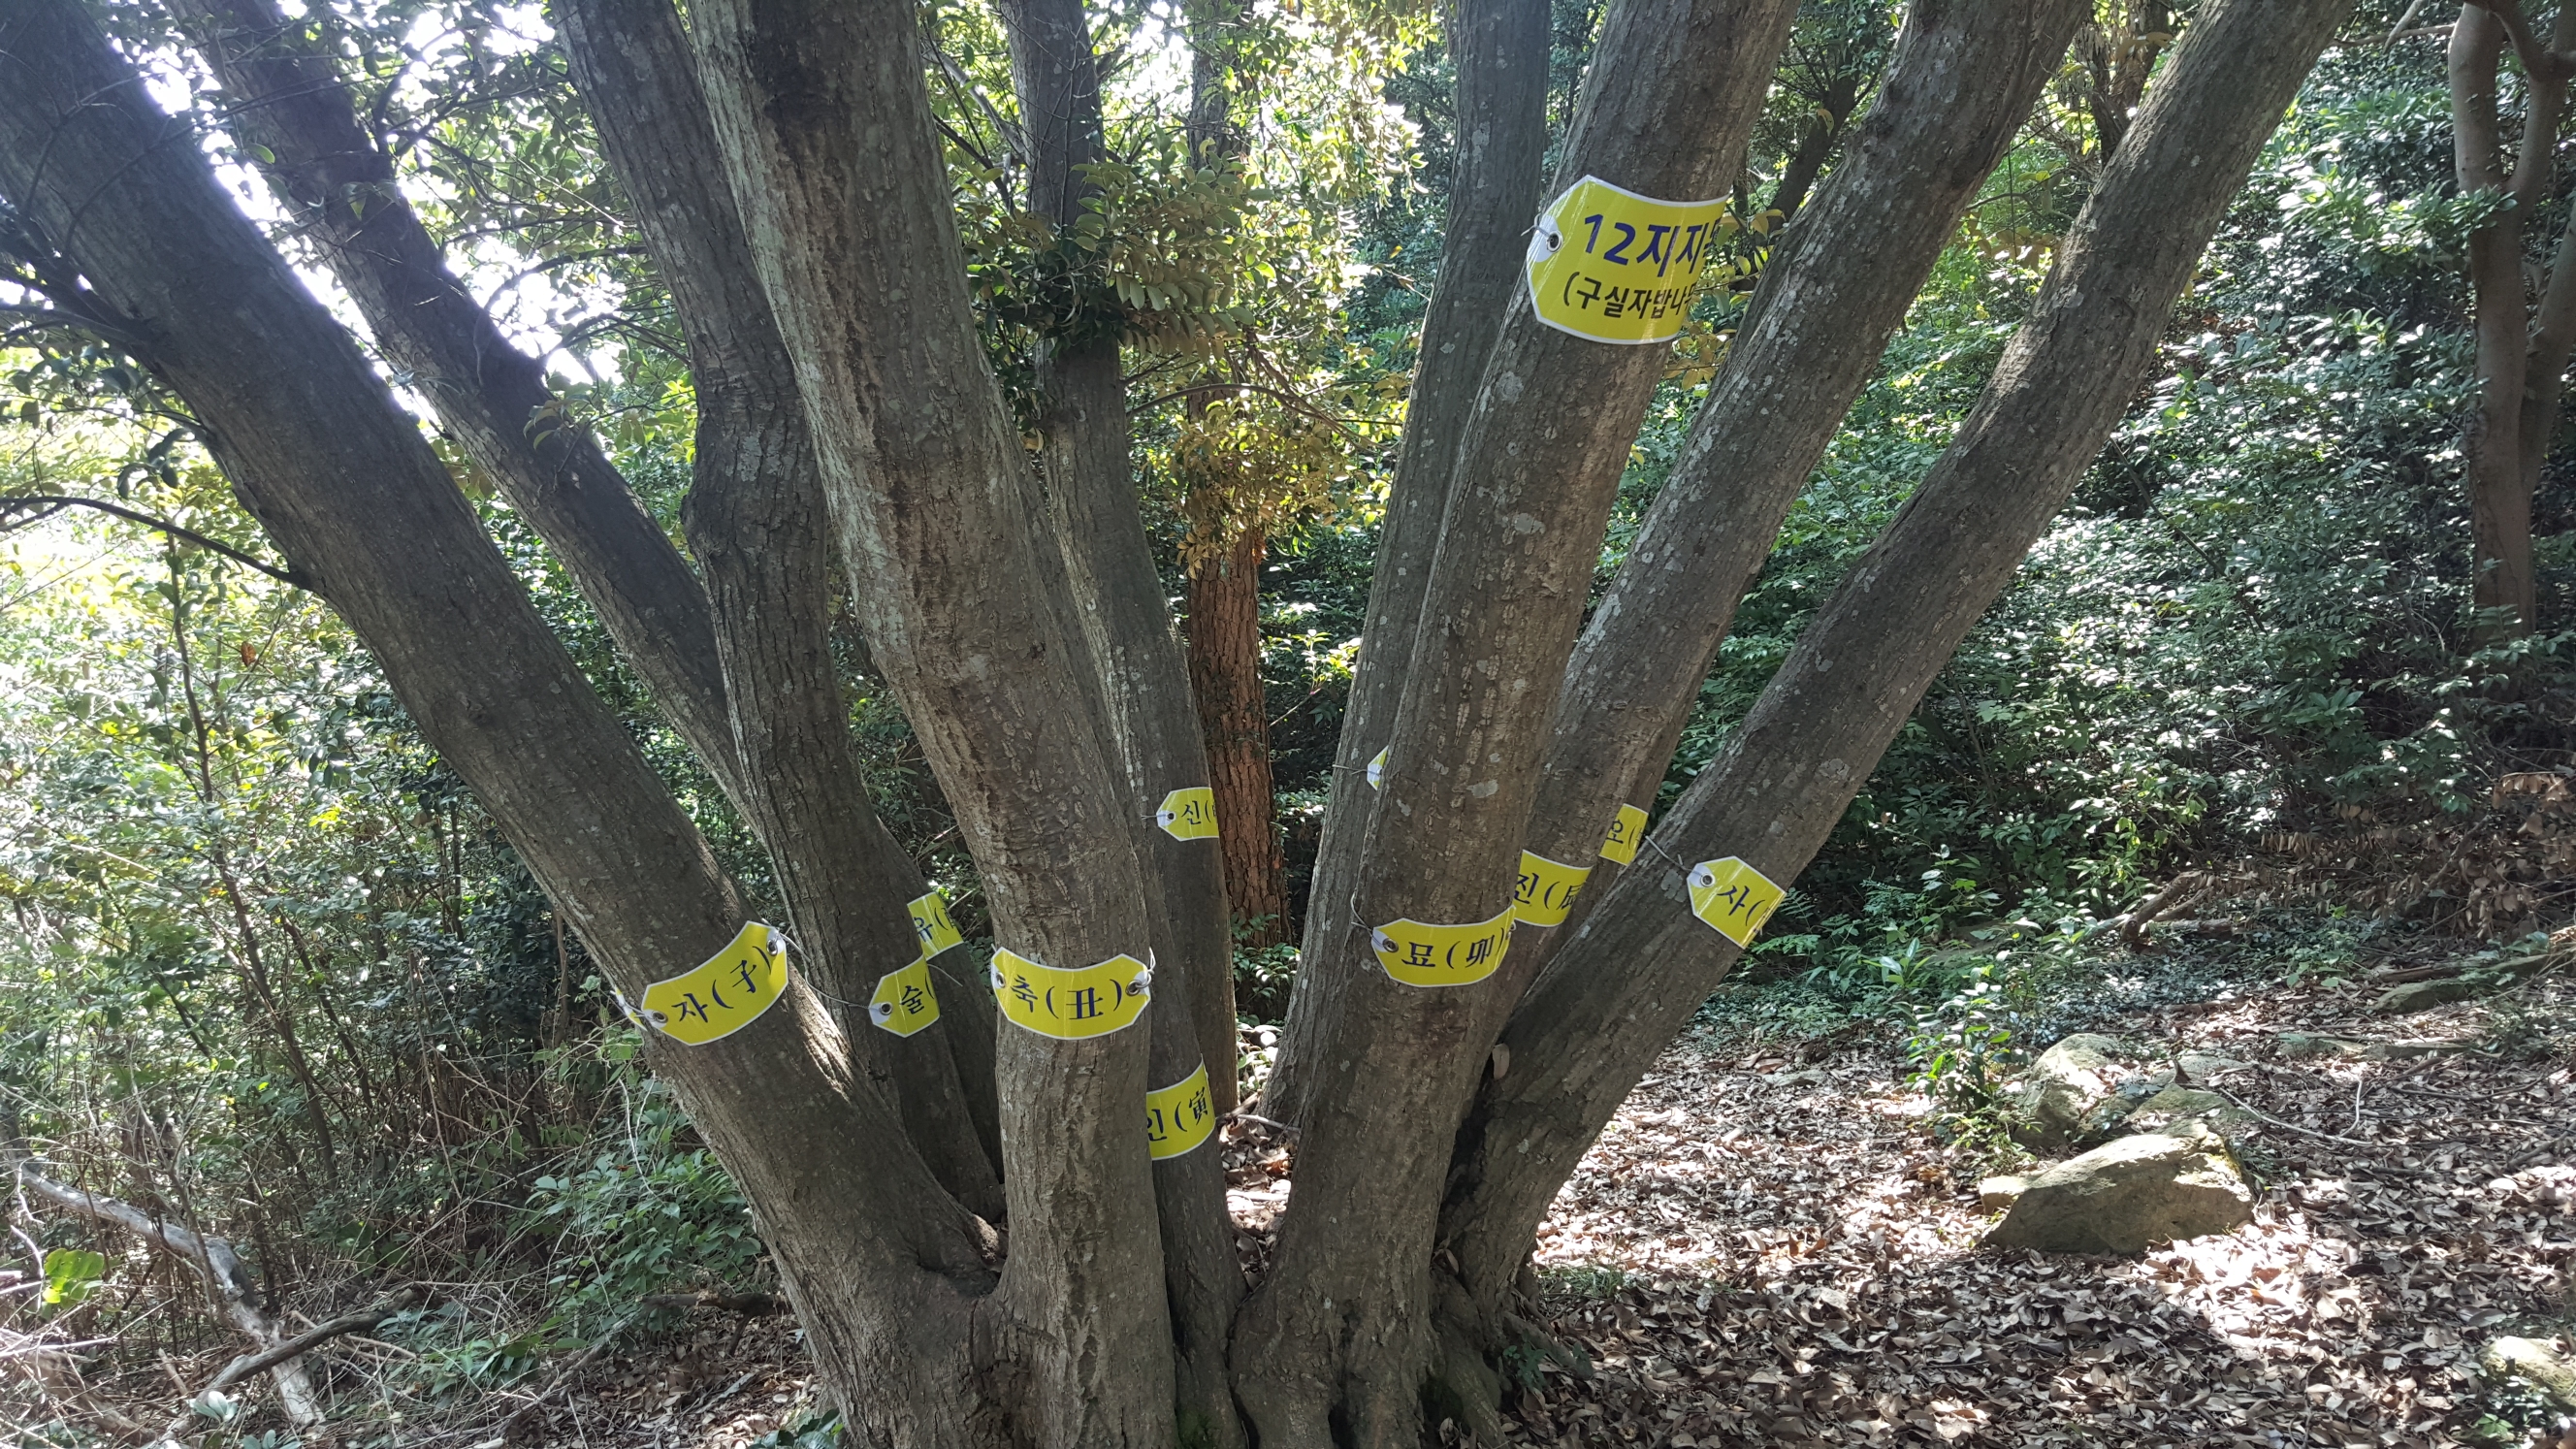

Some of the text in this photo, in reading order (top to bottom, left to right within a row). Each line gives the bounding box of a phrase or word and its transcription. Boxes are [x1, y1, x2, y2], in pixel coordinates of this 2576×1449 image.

[1606, 820, 1643, 851] 오(
[1717, 885, 1770, 933] 사(
[1401, 927, 1504, 969] 묘(卯)
[671, 945, 772, 1023] 자(子)
[1011, 975, 1122, 1020] 축(丑)
